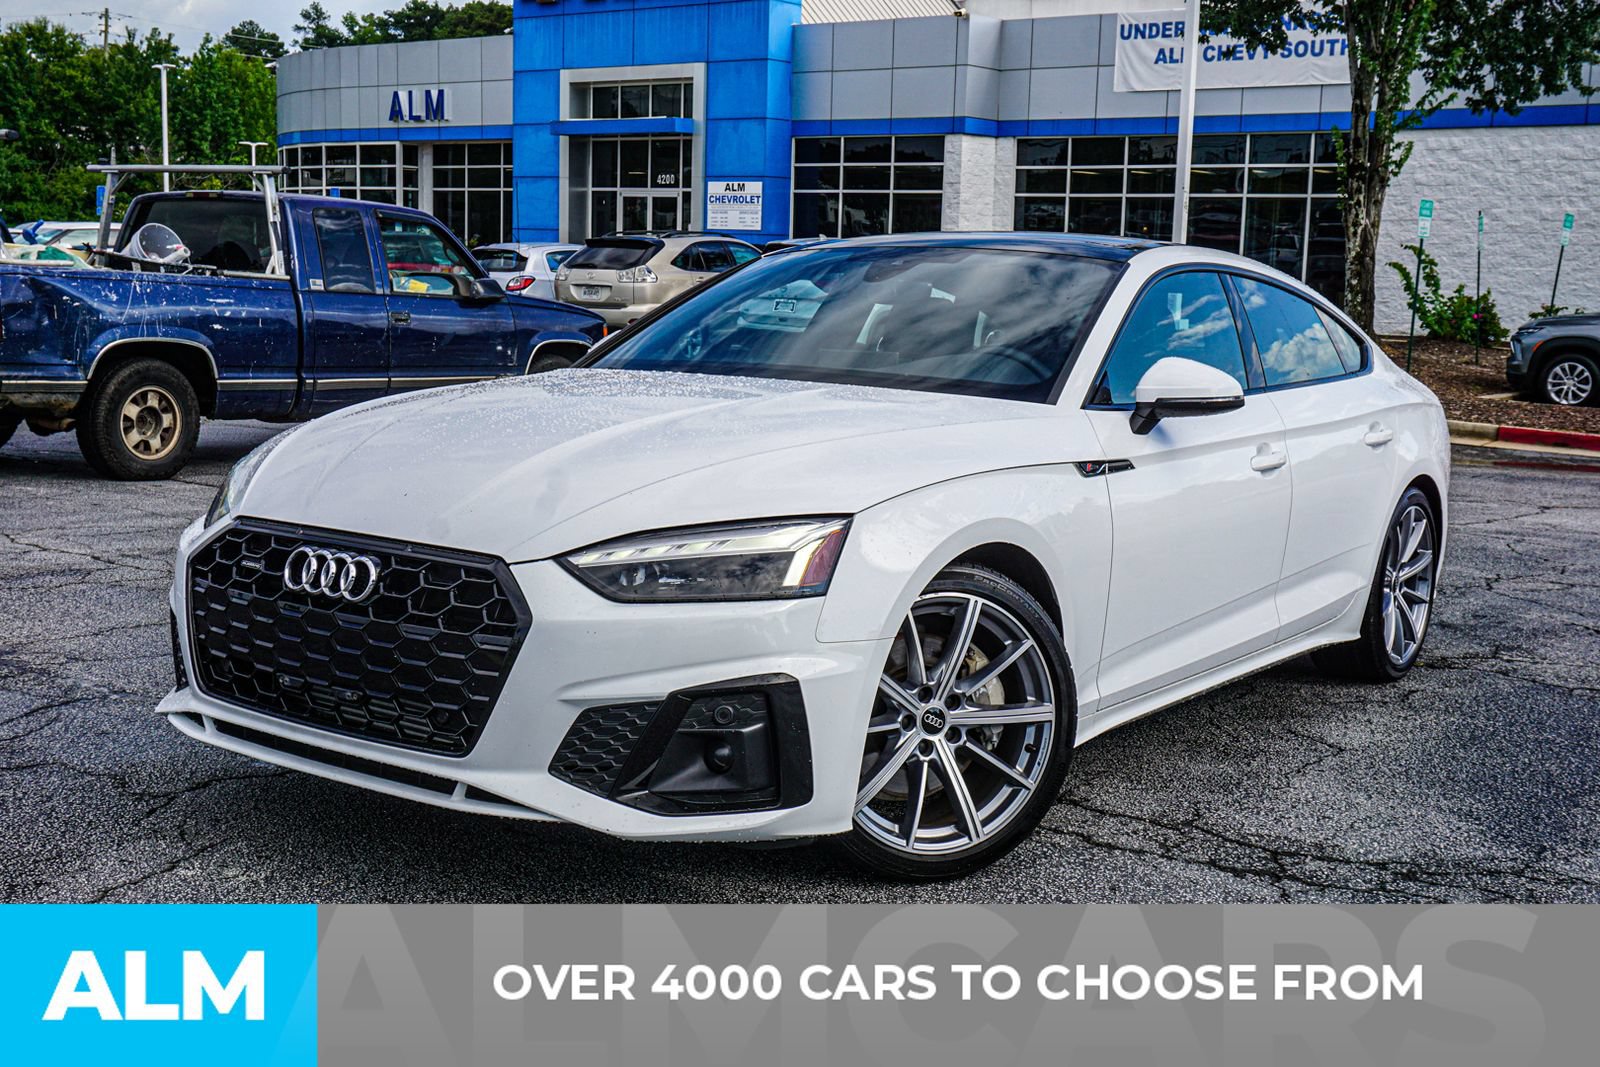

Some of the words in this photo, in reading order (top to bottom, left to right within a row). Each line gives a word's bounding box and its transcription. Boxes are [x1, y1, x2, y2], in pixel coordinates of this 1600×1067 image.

[1120, 21, 1185, 40] UNDER
[389, 89, 445, 121] ALM
[656, 174, 675, 185] 4200
[724, 183, 746, 192] ALM
[708, 195, 761, 204] CHEVROLET
